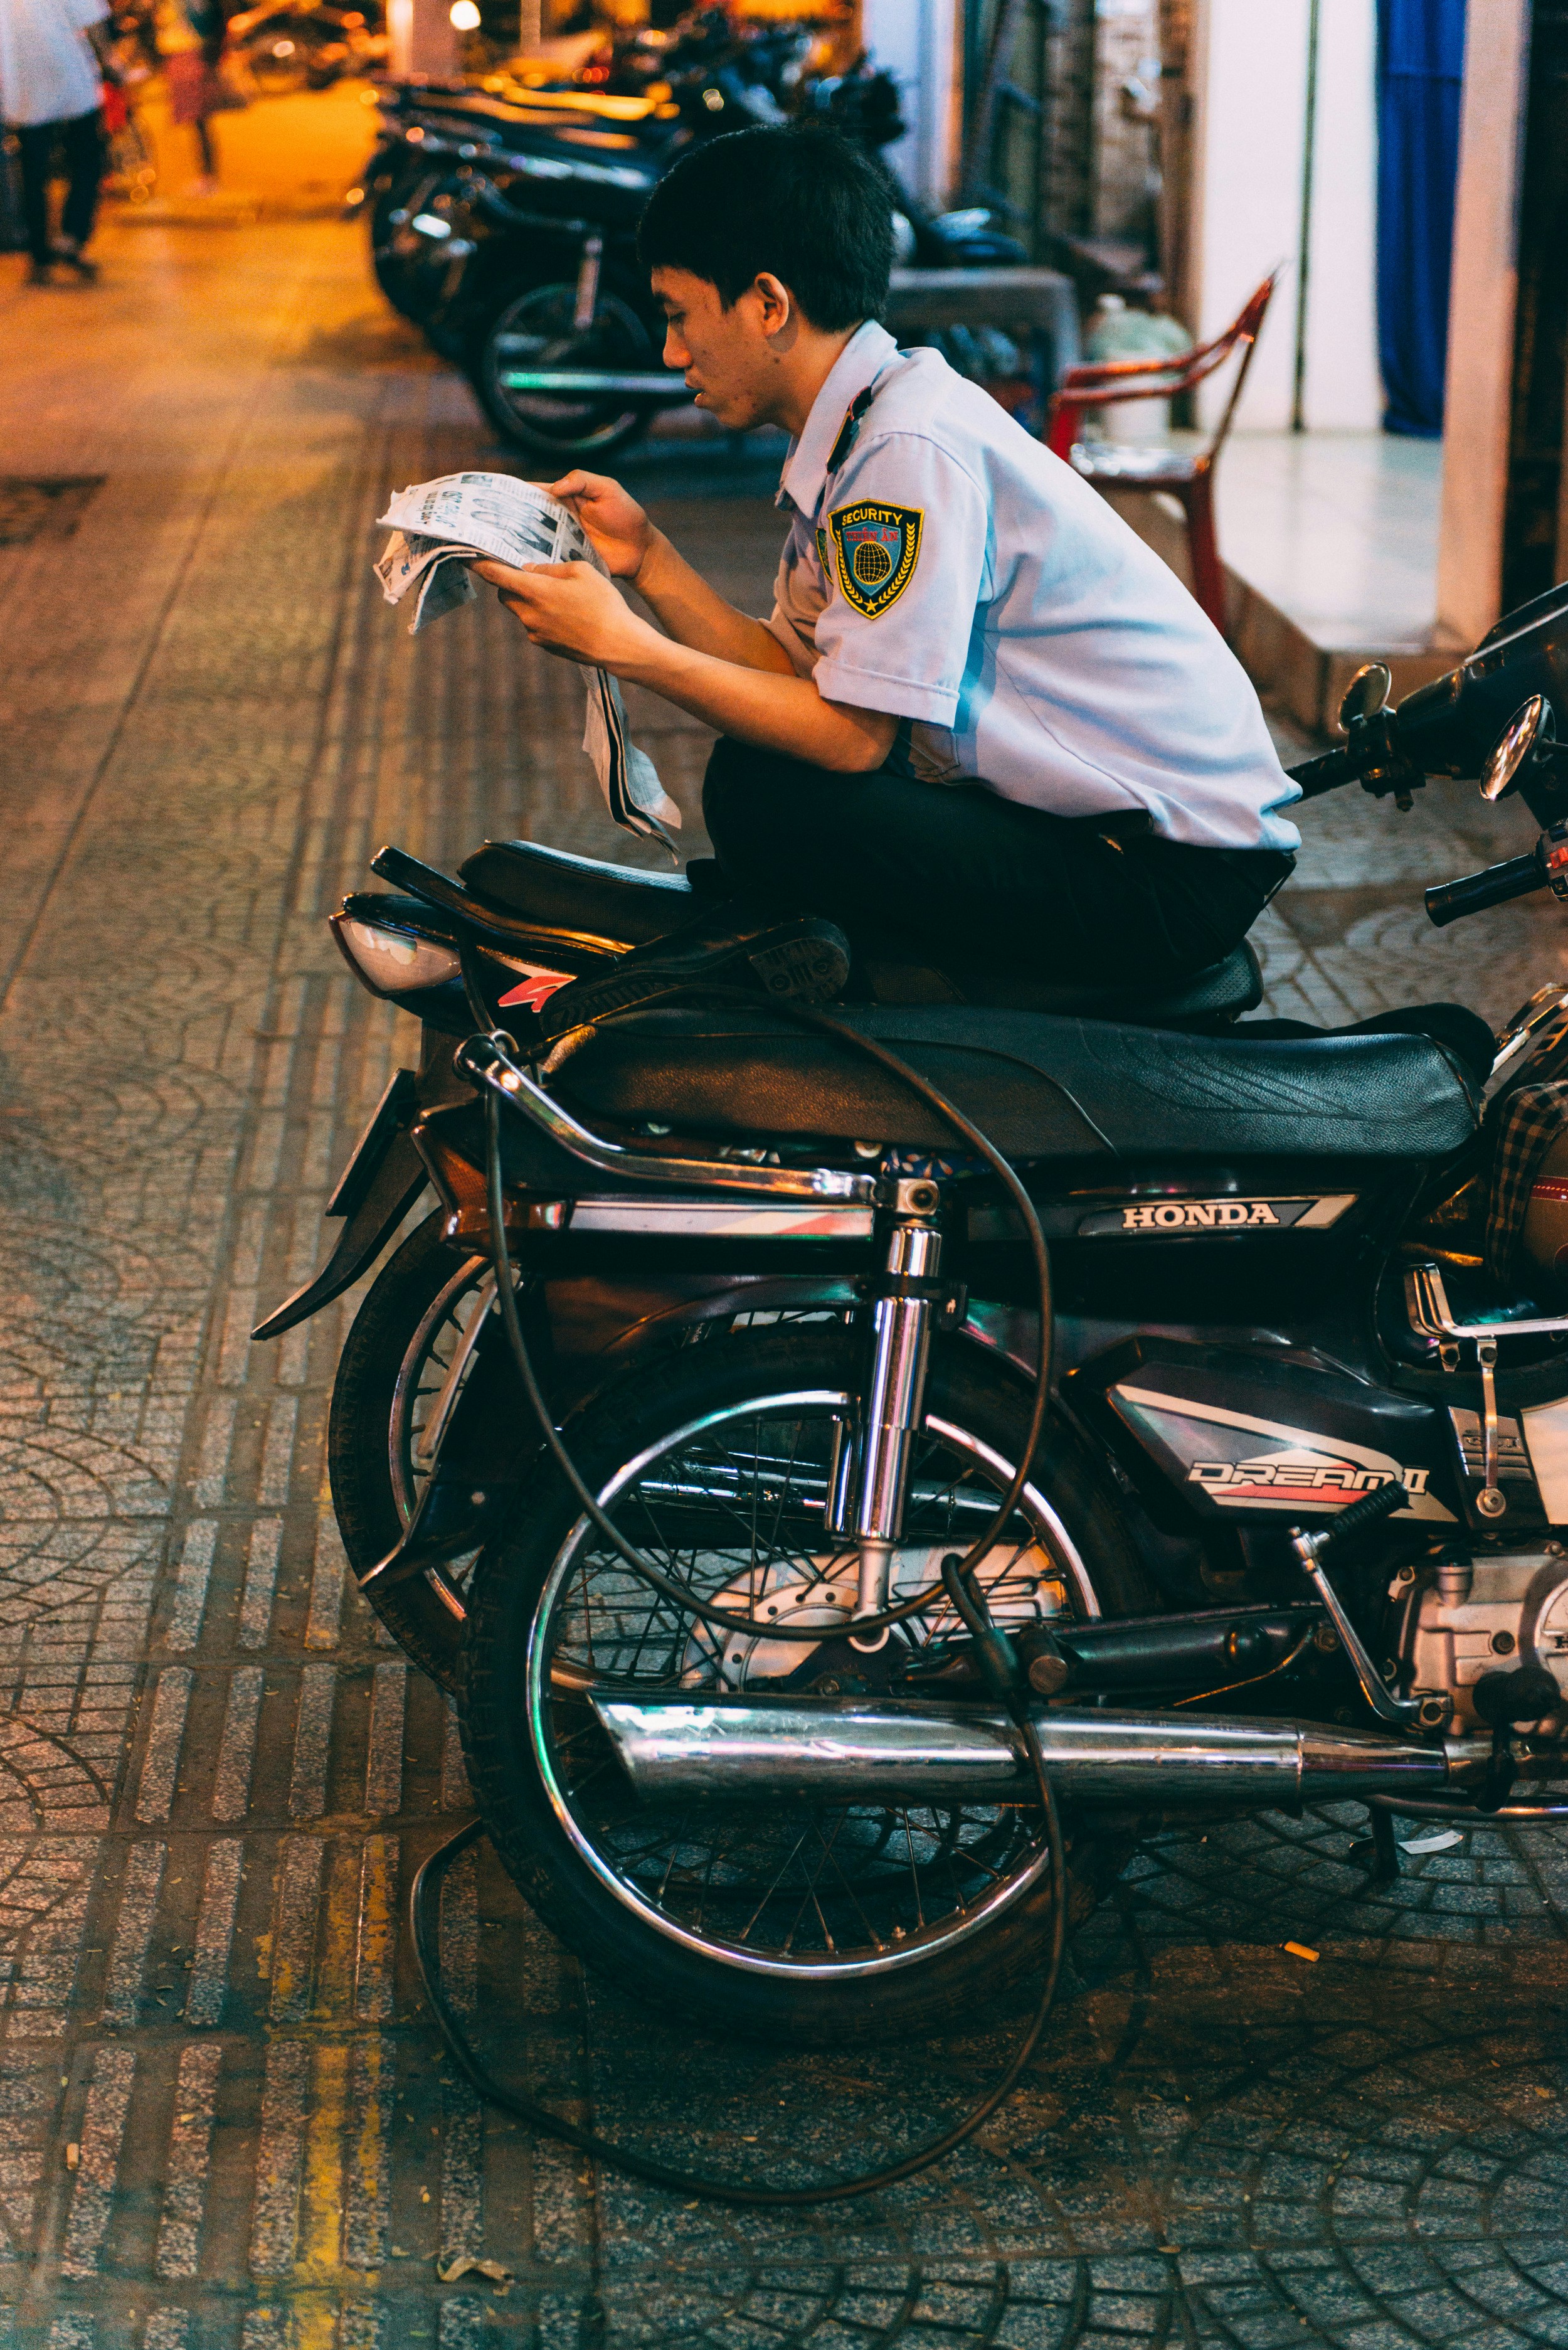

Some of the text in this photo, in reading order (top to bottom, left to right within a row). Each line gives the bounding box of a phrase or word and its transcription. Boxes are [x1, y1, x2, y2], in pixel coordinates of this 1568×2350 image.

[842, 508, 903, 526] SECURITY
[845, 527, 899, 542] THIÊN ÂN
[1122, 1203, 1280, 1228] HONDA
[1188, 1462, 1396, 1491] DREAM
